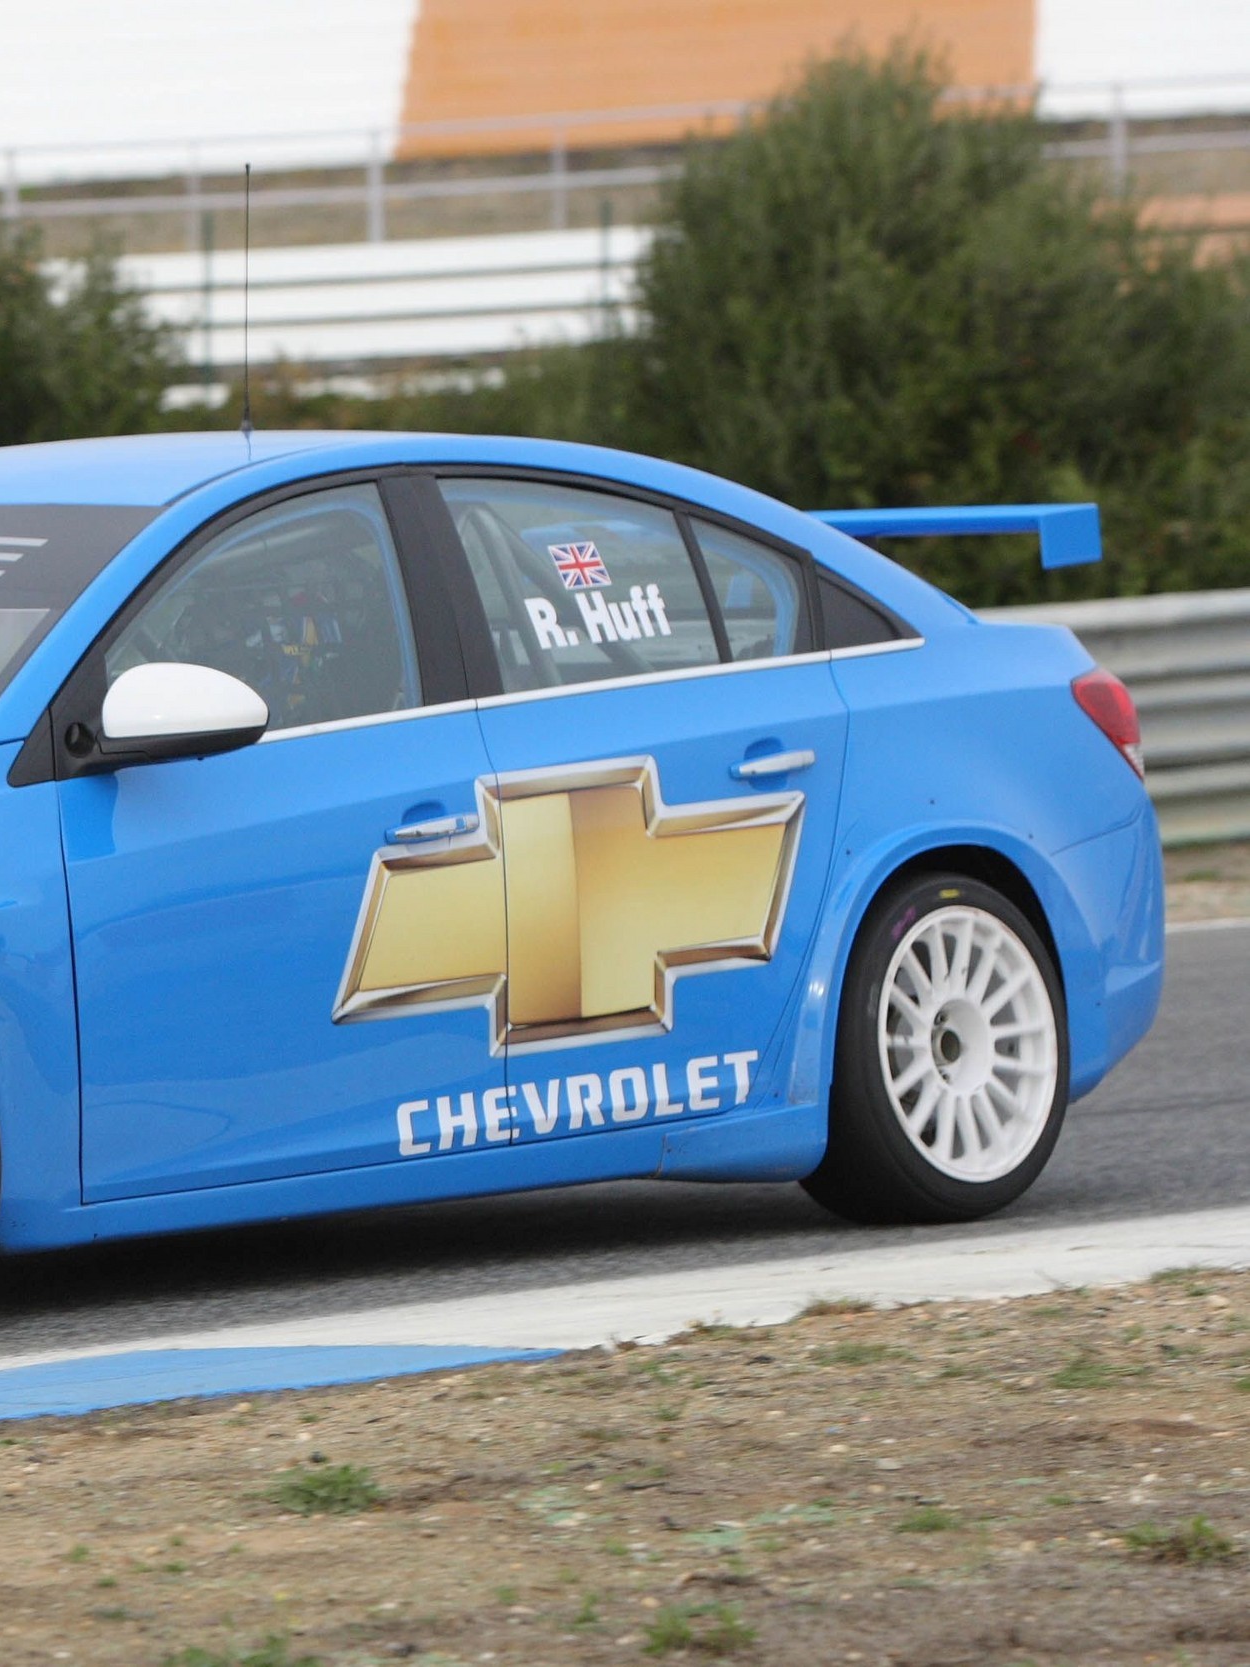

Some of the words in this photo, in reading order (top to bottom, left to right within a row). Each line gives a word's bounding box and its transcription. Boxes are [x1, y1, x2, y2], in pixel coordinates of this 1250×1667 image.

[524, 597, 580, 649] R.
[574, 584, 671, 643] Huff
[396, 1050, 759, 1156] CHEVROLET
